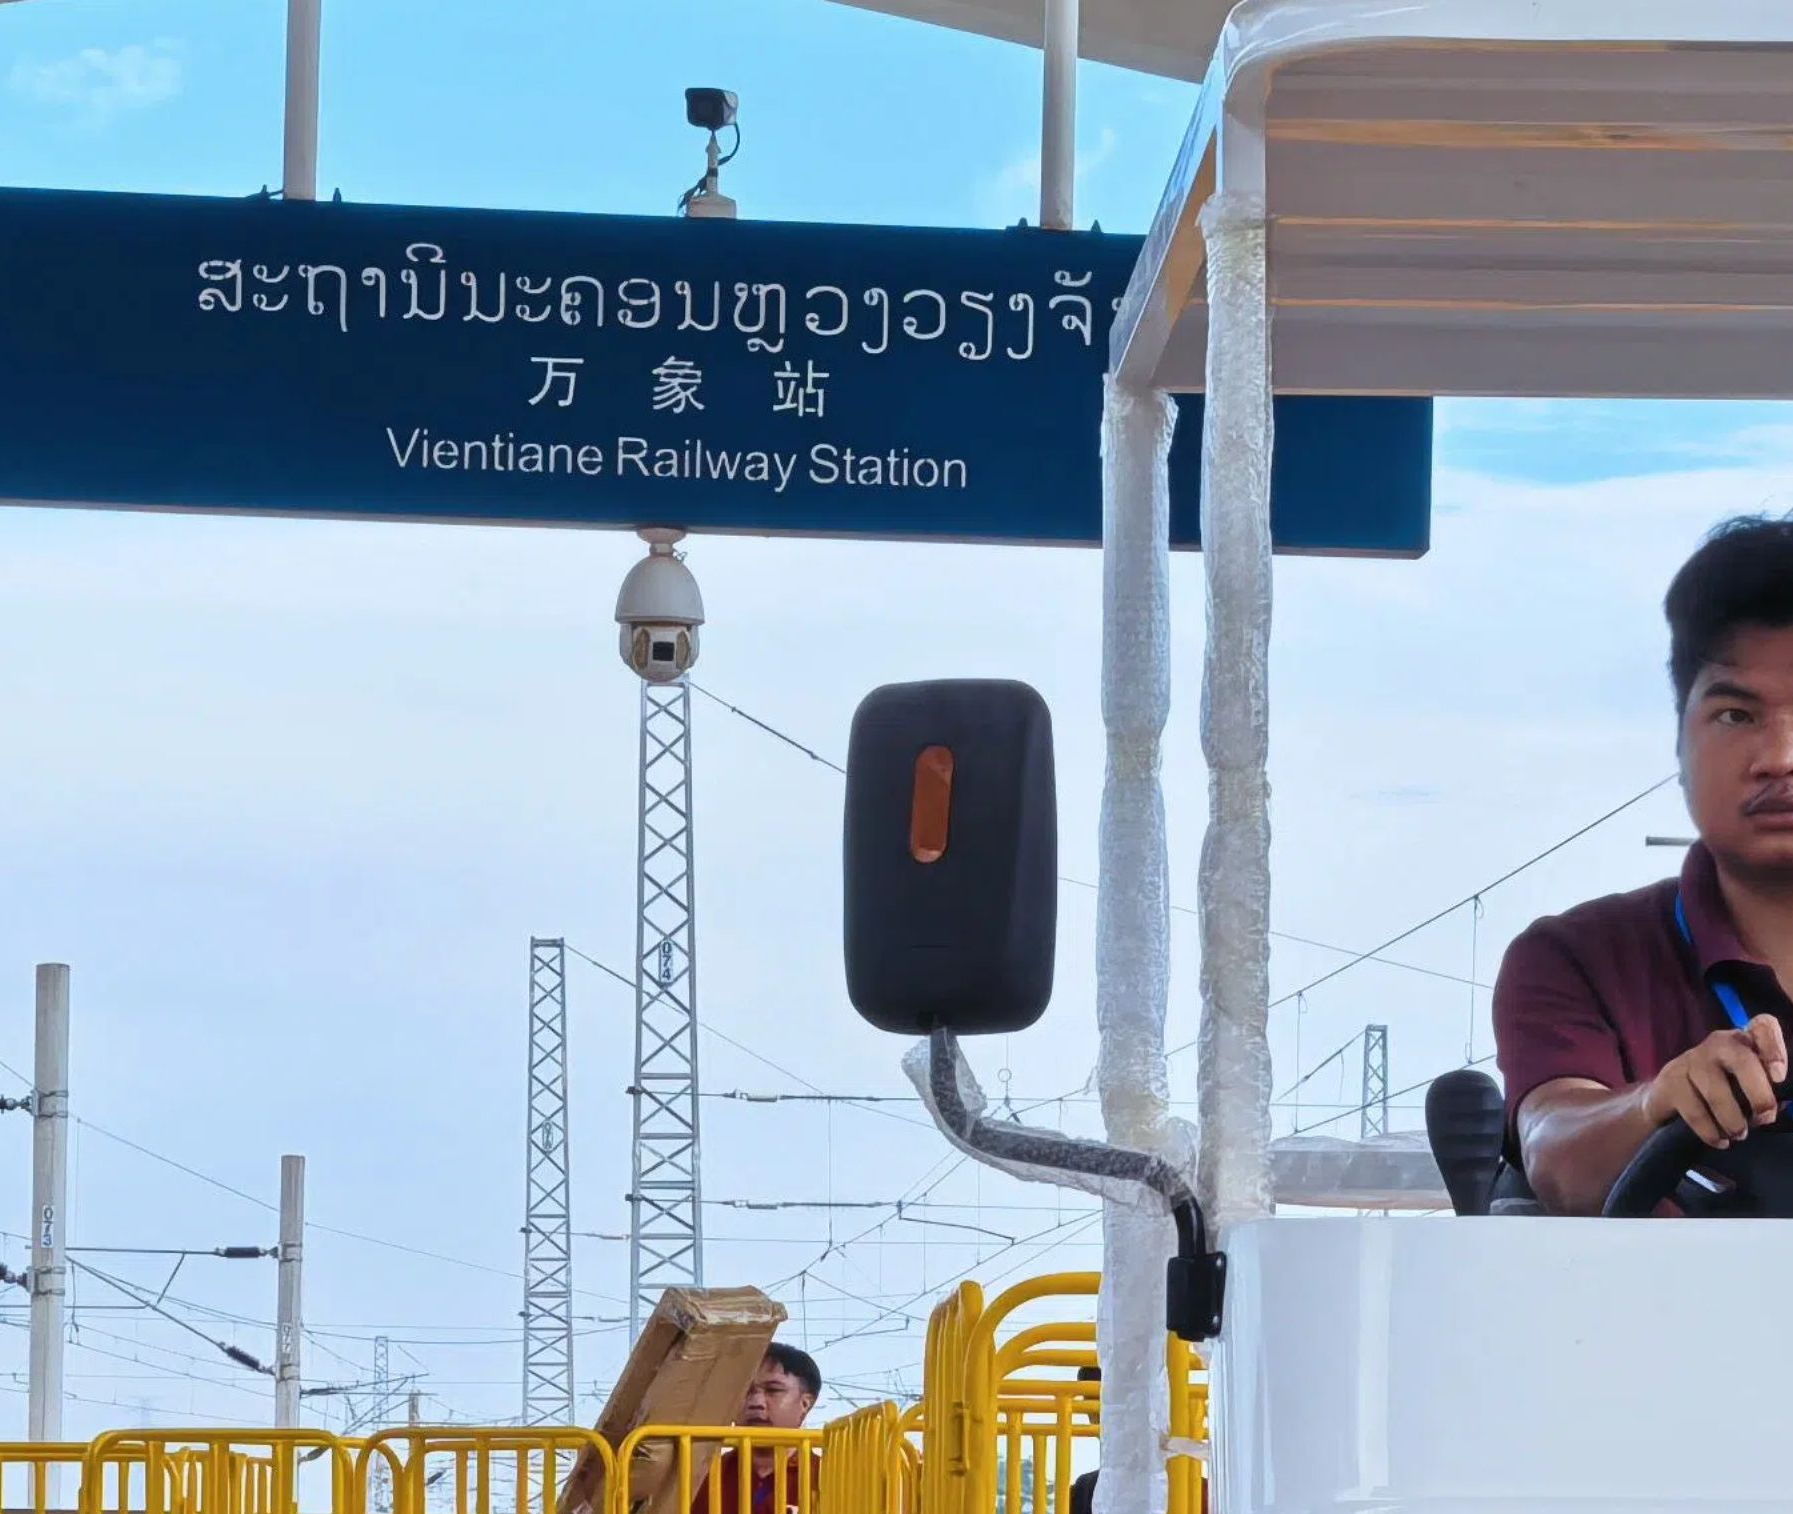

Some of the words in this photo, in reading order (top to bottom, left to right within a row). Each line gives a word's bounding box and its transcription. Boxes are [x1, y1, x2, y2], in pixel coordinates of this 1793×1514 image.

[198, 243, 1124, 361] ສະຖານີນະຄອນຫຼວງວຽງຈັ
[528, 355, 830, 417] 万象站
[386, 427, 603, 476] Vientiane
[616, 436, 797, 492] Railway
[809, 443, 967, 488] Station
